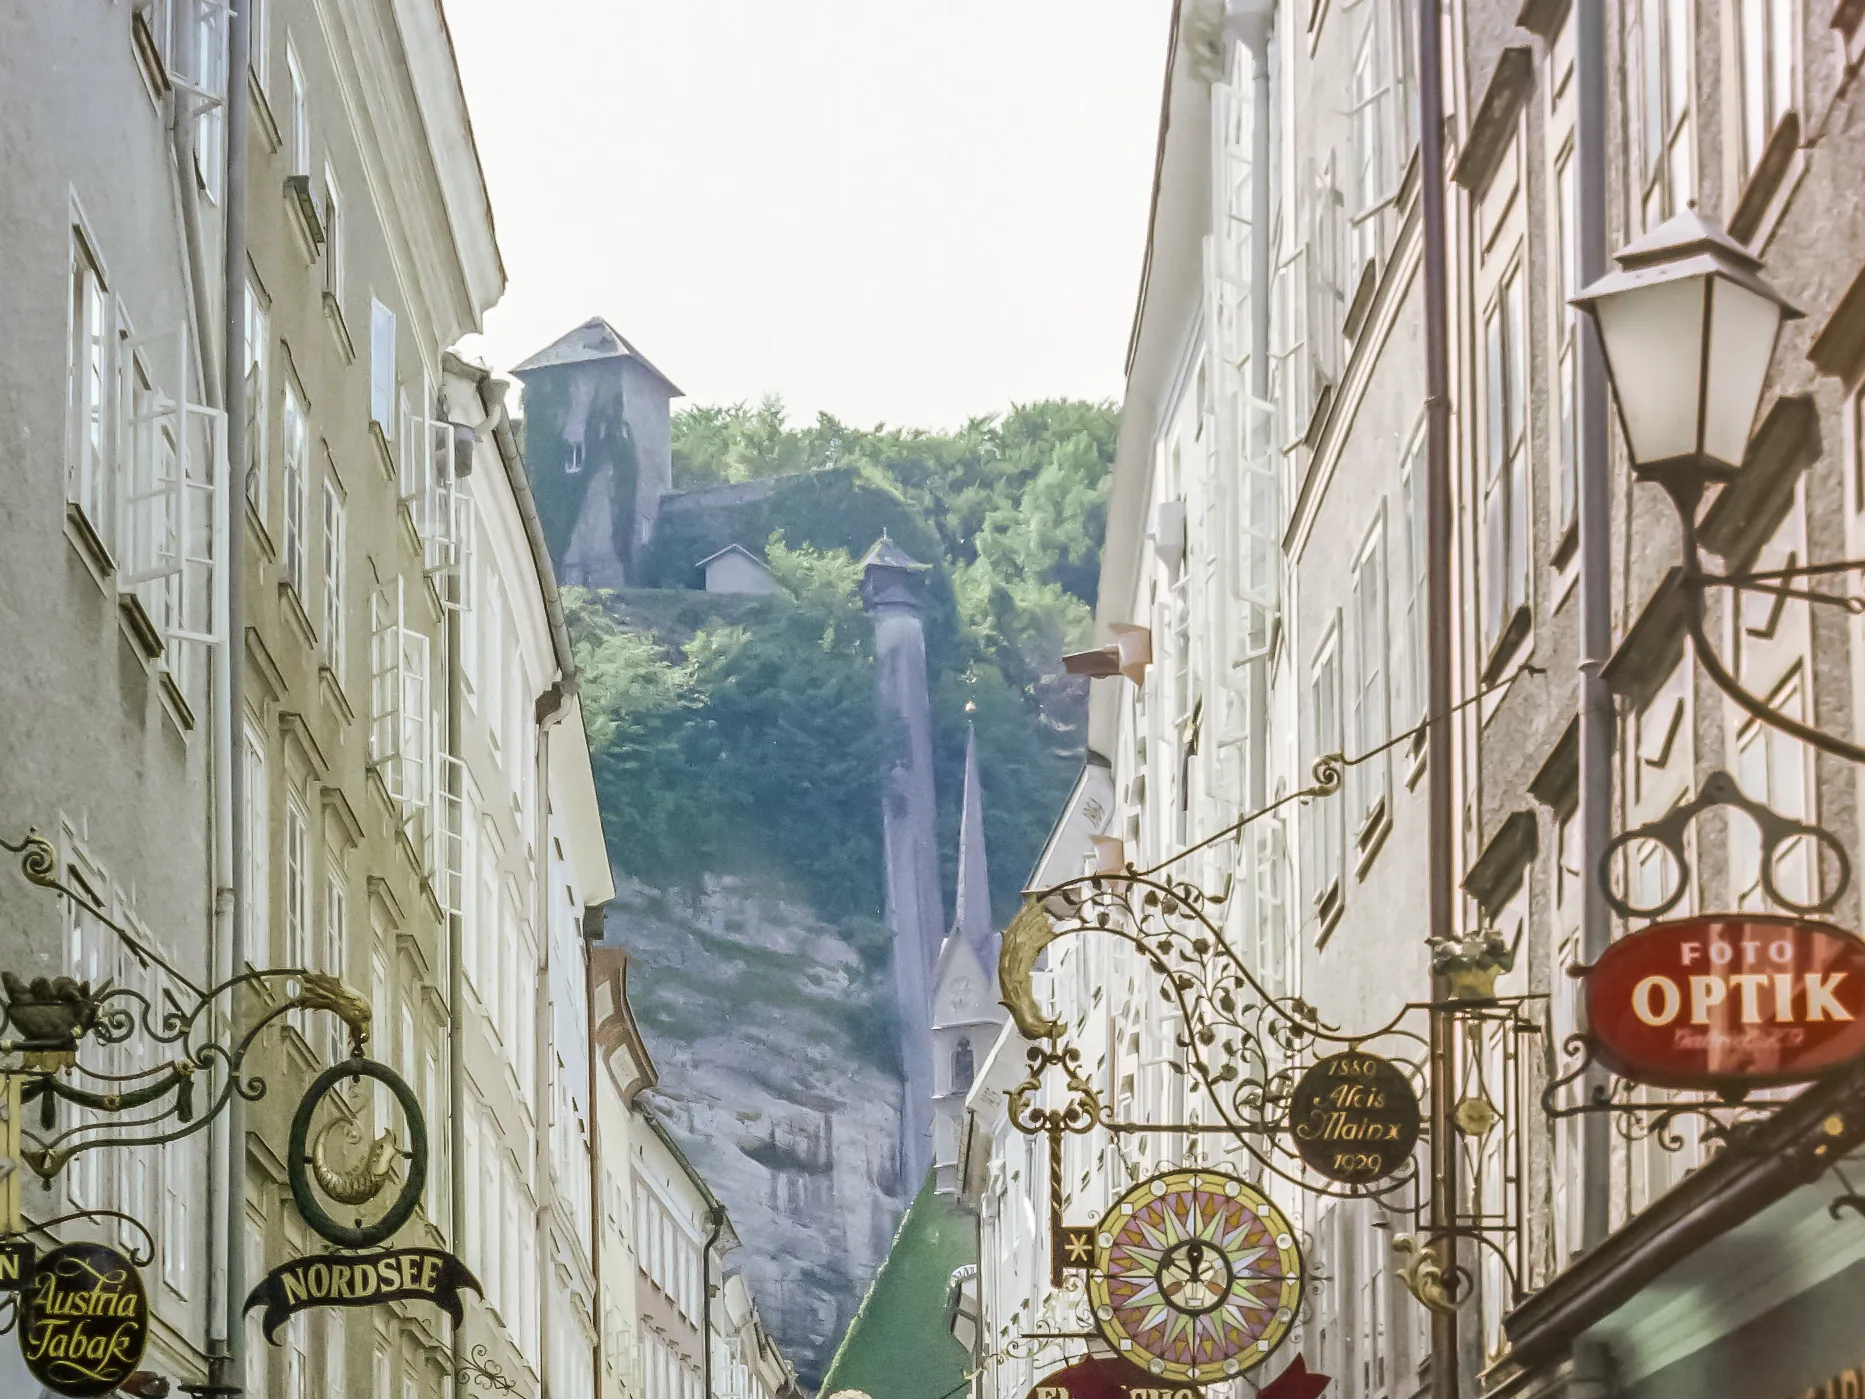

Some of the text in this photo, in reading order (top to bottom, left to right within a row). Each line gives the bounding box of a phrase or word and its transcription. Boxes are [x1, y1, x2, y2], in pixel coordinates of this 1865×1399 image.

[1680, 940, 1794, 967] FOTO
[1631, 971, 1857, 1027] OPTIK
[1333, 1153, 1382, 1176] 1929
[34, 1269, 138, 1318] Austria
[280, 1254, 443, 1306] NORDSEE
[26, 1318, 140, 1374] Tabak
